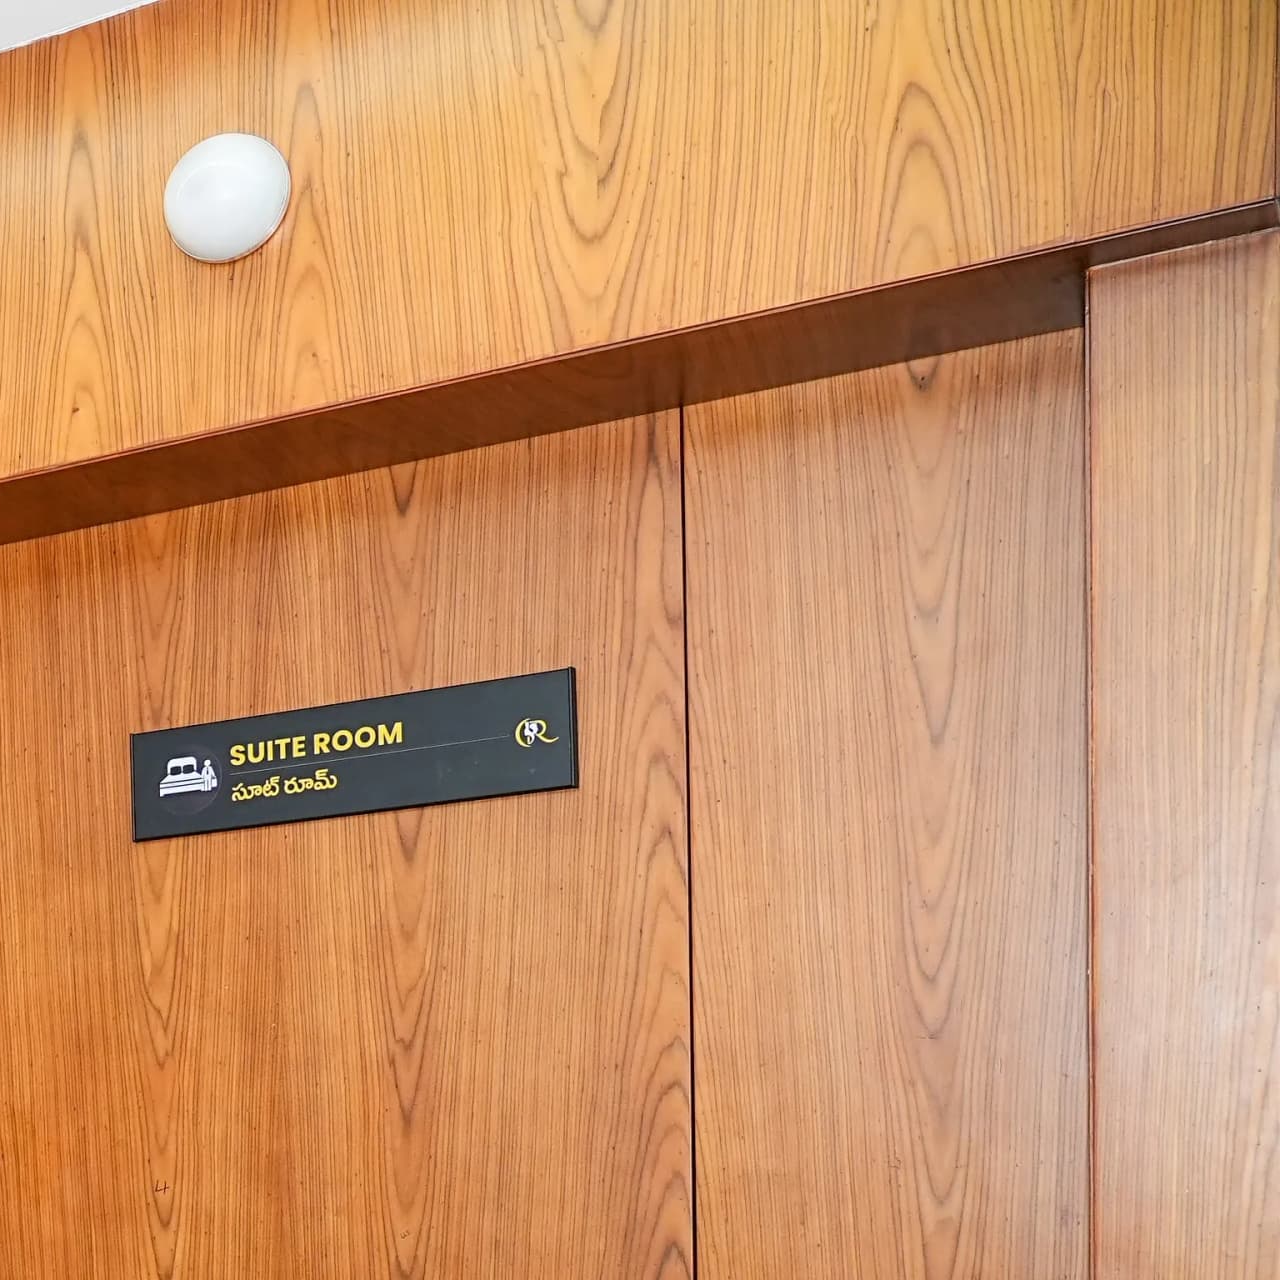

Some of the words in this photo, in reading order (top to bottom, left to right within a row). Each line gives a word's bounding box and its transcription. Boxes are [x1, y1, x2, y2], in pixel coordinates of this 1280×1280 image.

[229, 735, 306, 766] SUITE
[313, 721, 403, 755] ROOM
[231, 776, 280, 801] సూట్
[284, 769, 338, 794] రూమ్
